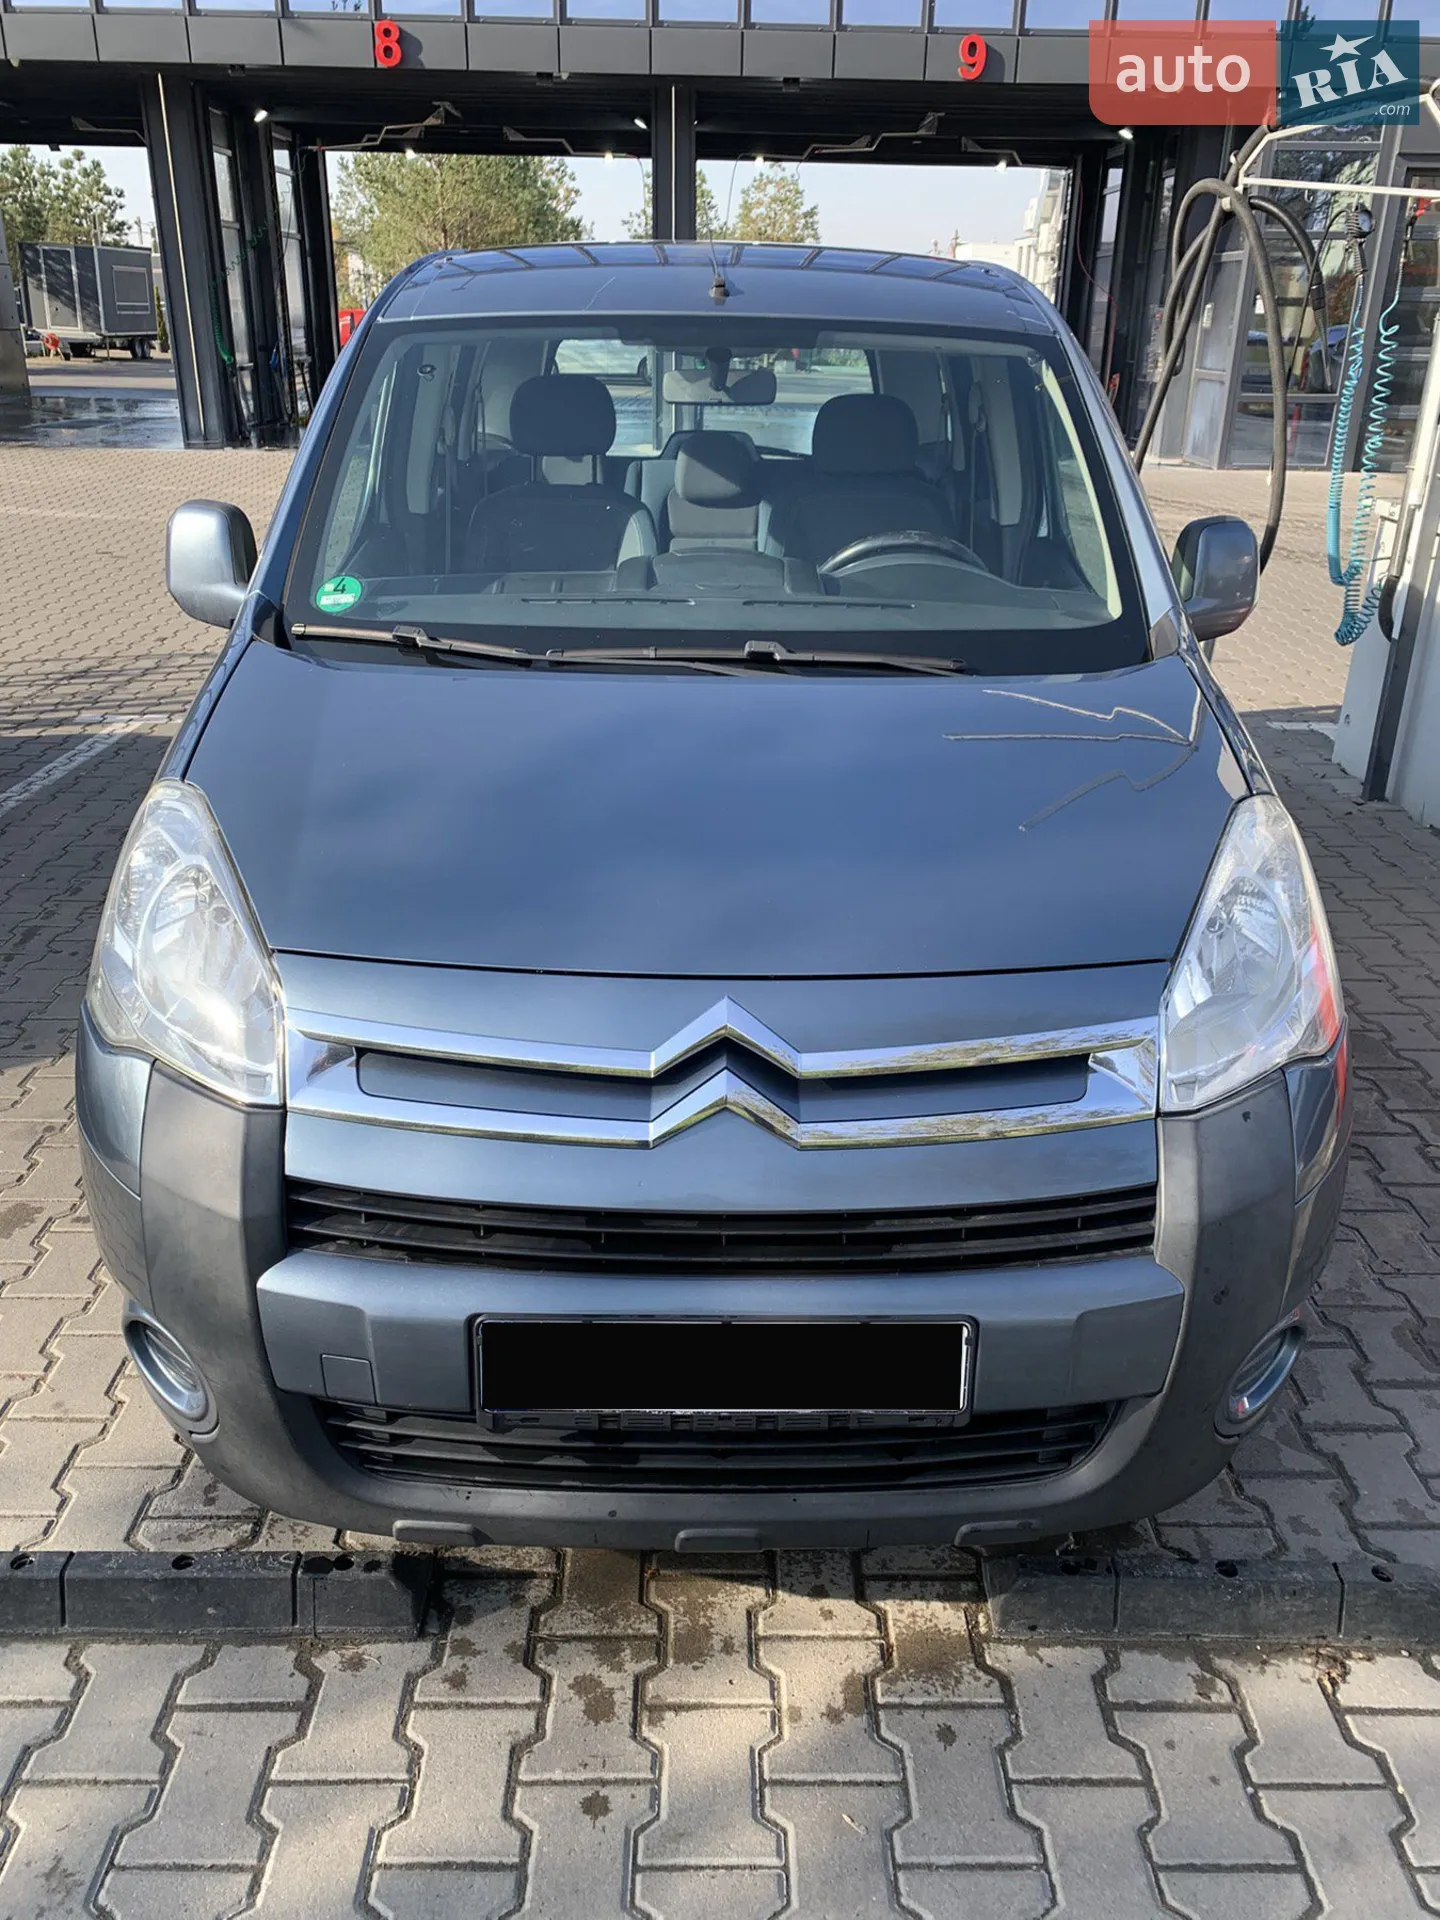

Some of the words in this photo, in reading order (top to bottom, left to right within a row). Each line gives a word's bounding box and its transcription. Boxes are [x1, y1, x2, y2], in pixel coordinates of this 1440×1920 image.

[375, 20, 402, 67] 8
[958, 33, 987, 80] 9
[333, 577, 346, 593] 4
